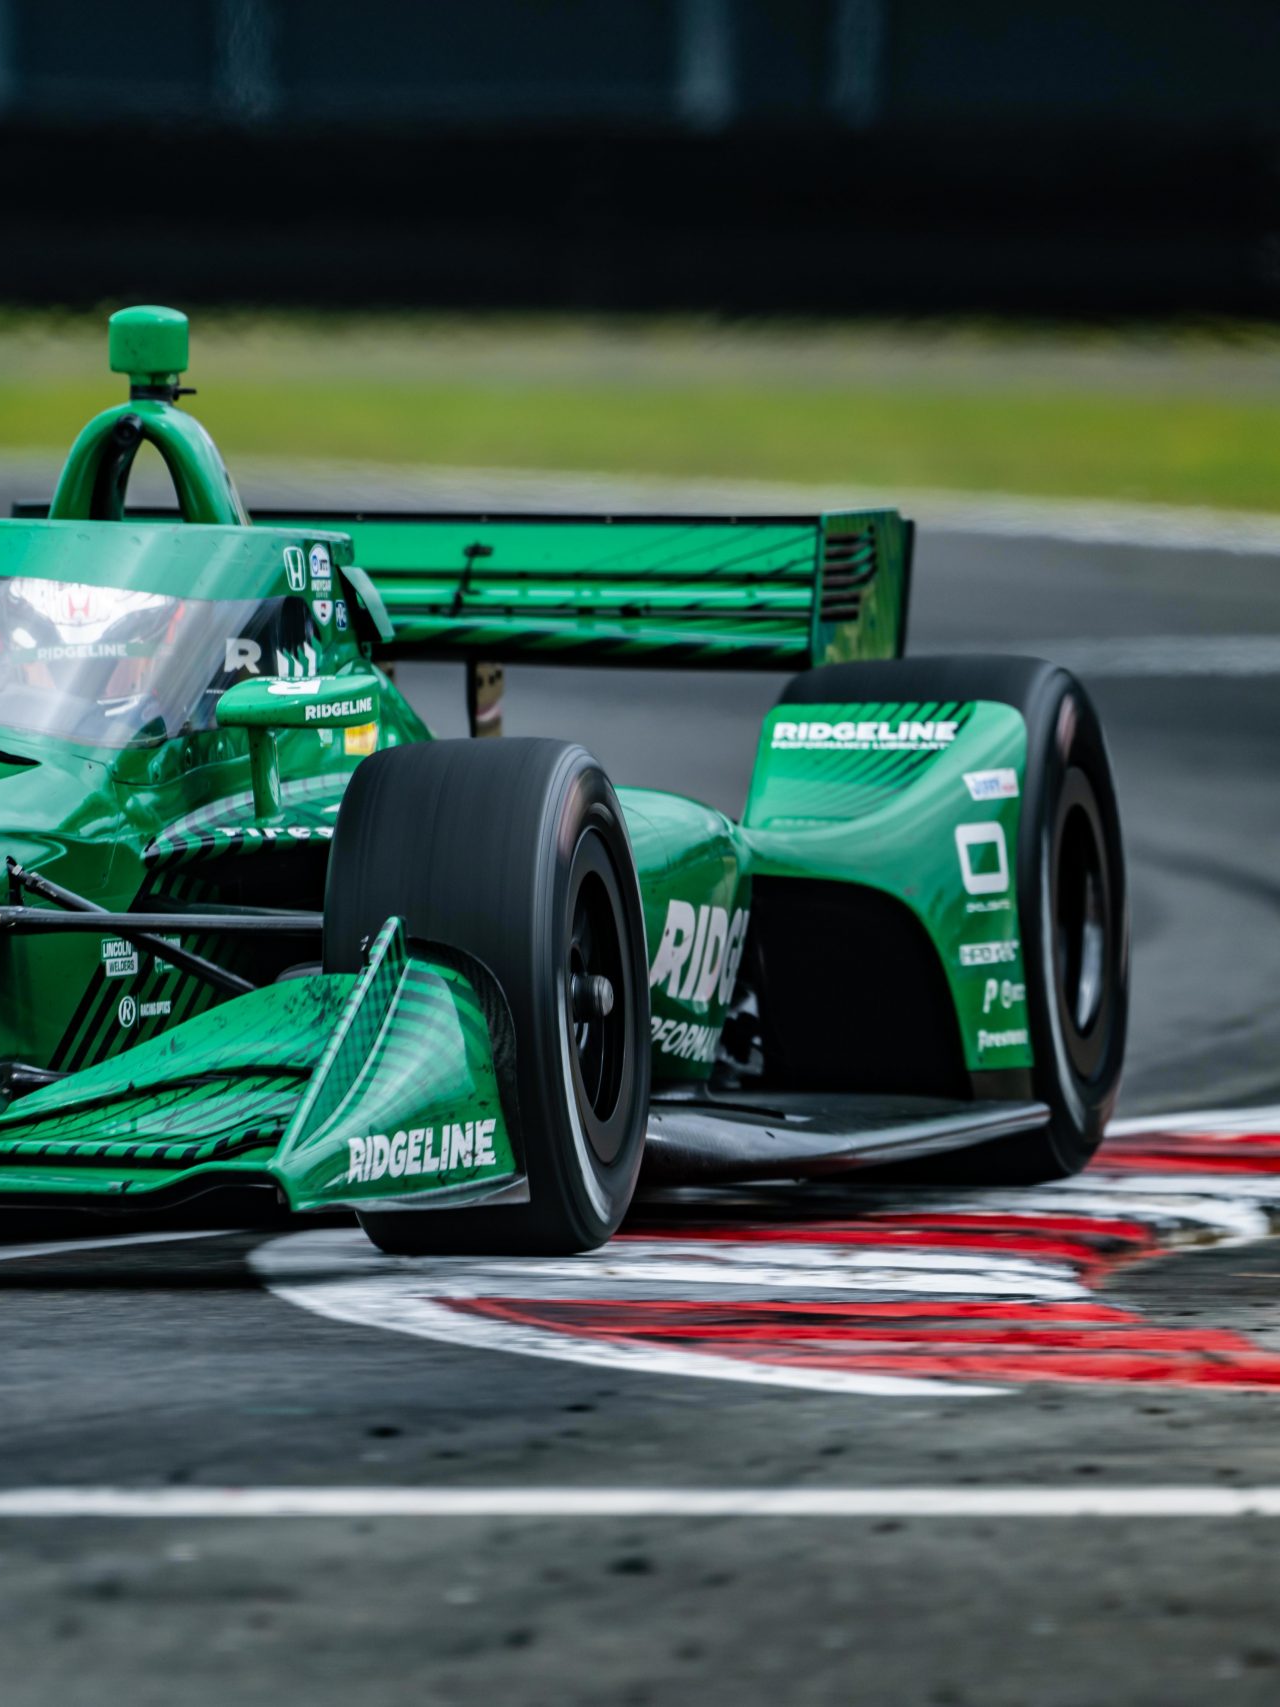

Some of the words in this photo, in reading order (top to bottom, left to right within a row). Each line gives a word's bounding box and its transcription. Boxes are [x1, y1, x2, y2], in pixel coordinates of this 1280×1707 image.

[37, 644, 127, 660] RIDGELINE
[223, 638, 262, 674] R
[305, 697, 372, 721] RIDGELINE
[773, 721, 959, 741] RIDGELINE
[103, 940, 132, 958] LINCOLN
[109, 960, 135, 973] WELDERS
[348, 1118, 497, 1185] RIDGELINE
